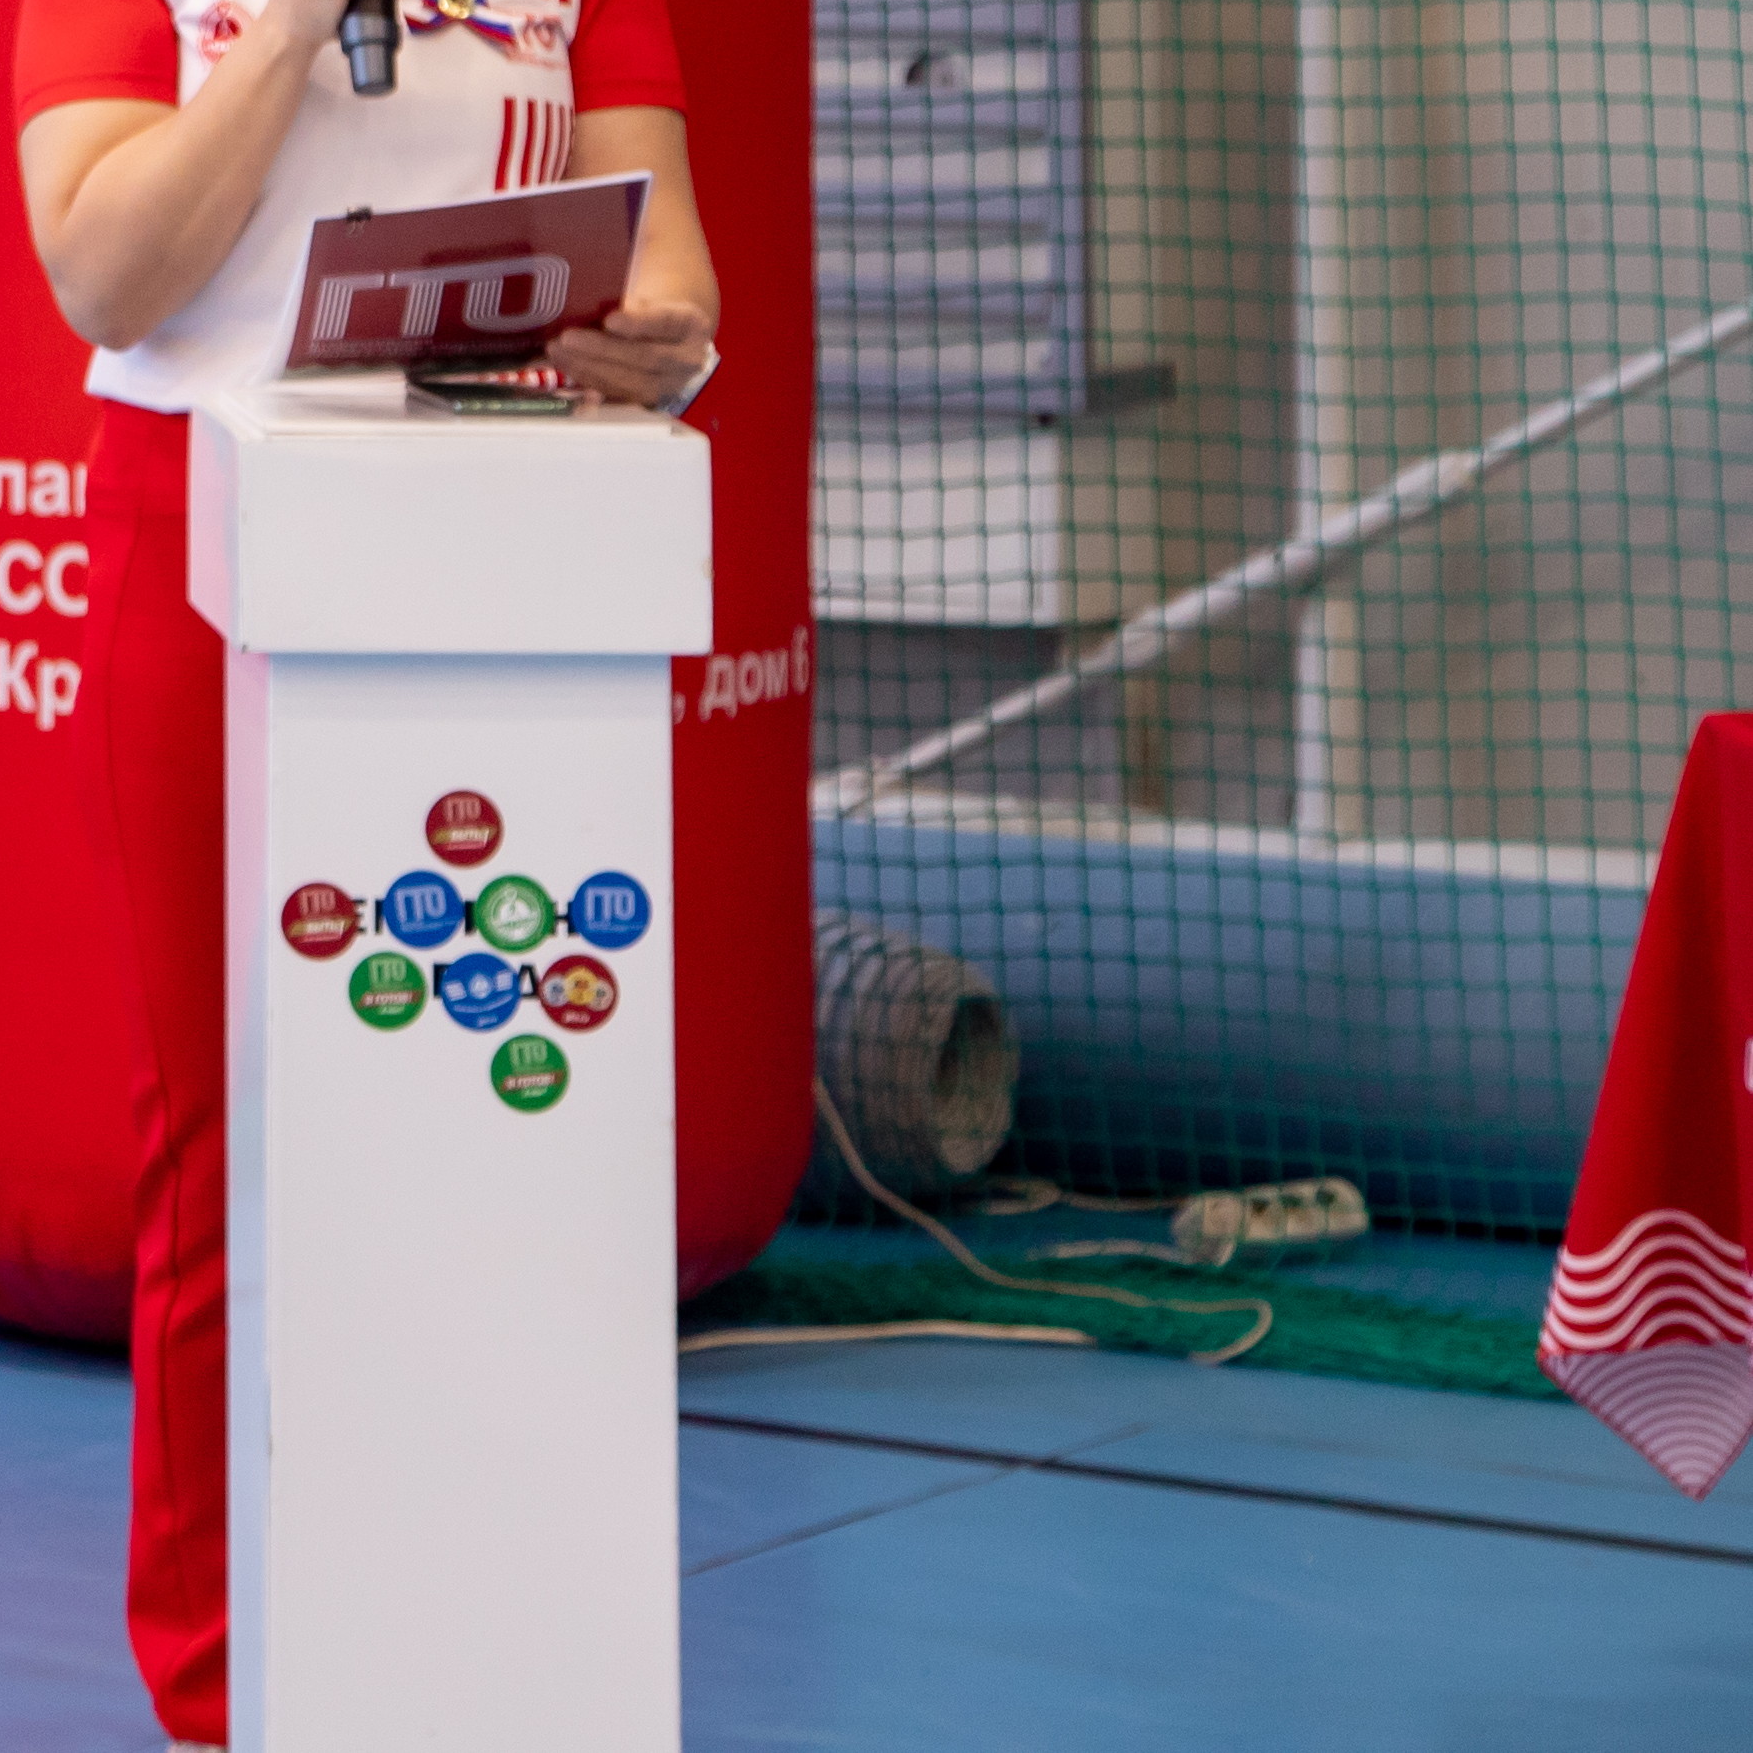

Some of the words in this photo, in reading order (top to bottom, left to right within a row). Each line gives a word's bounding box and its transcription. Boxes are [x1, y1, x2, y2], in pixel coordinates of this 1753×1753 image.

[311, 254, 570, 342] ГТО
[698, 649, 789, 733] дом
[393, 884, 447, 923] ГТО
[584, 885, 636, 927] ГТО
